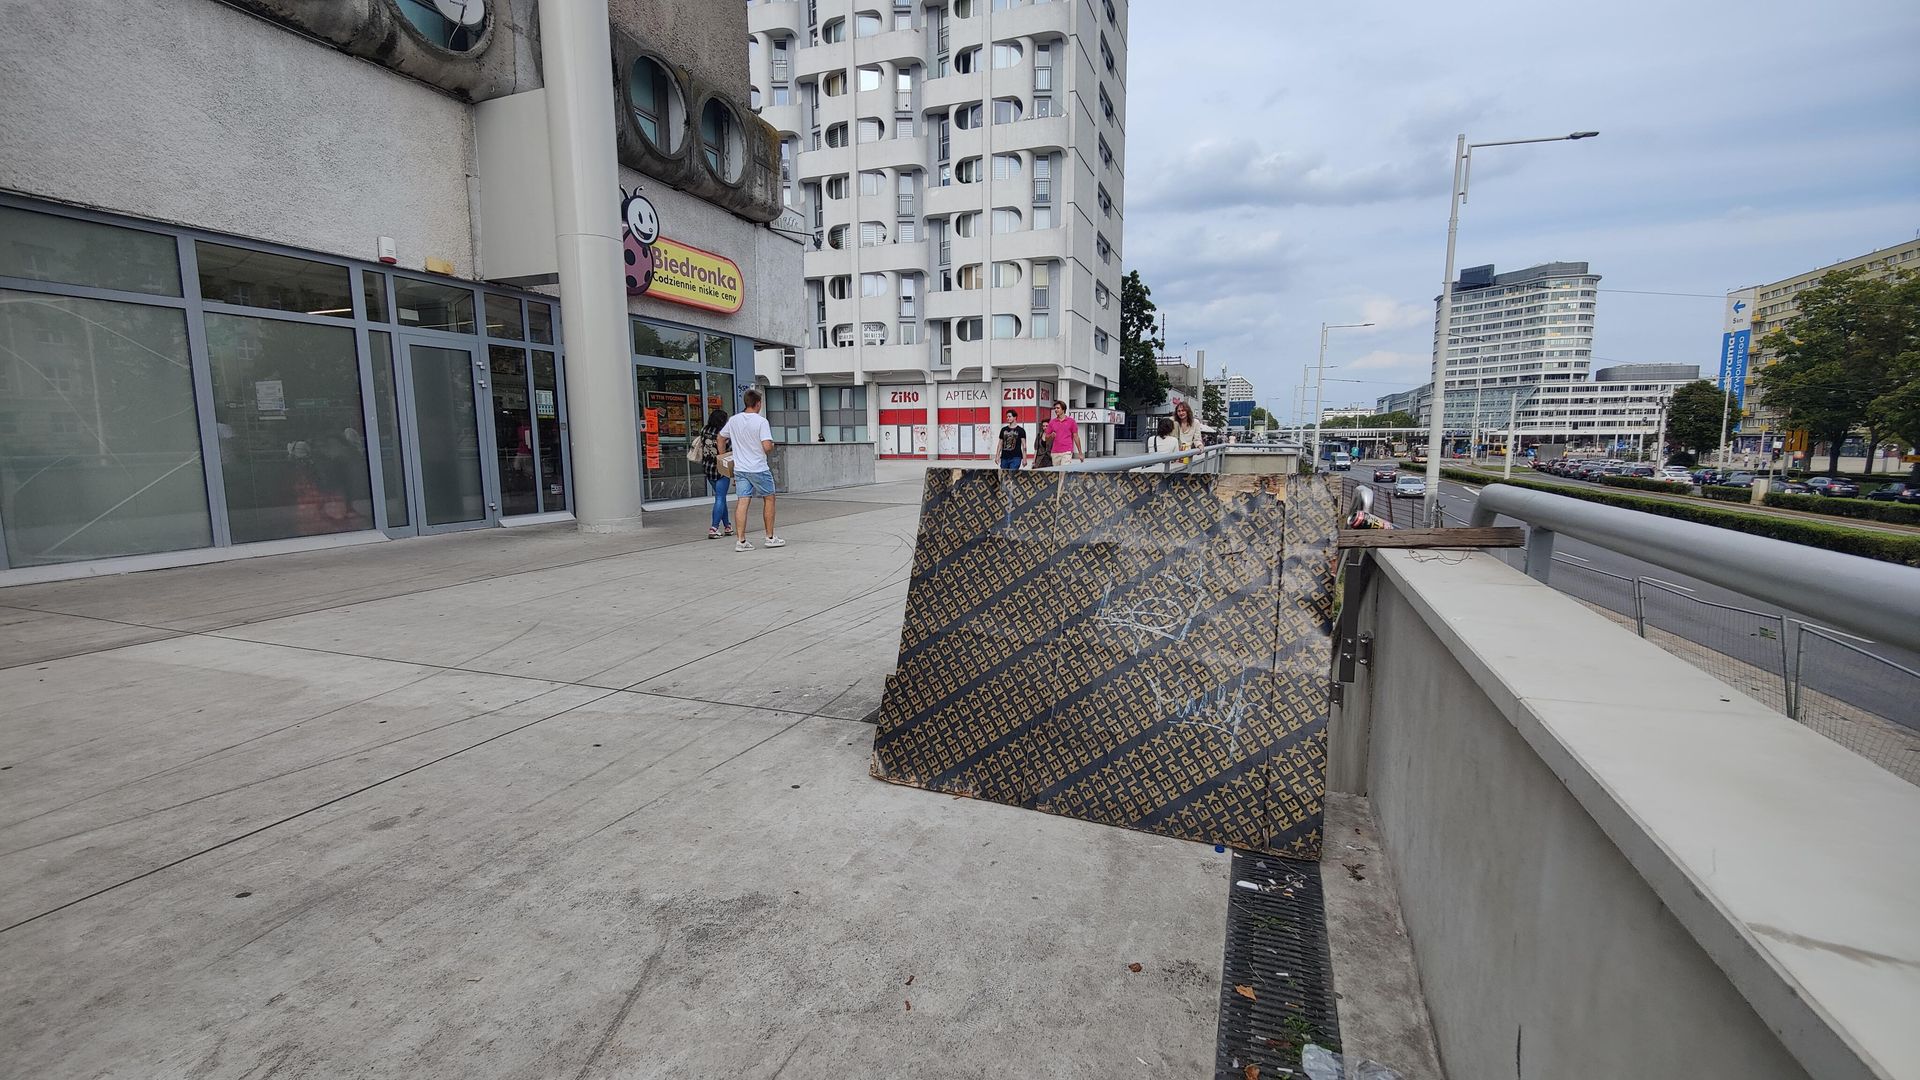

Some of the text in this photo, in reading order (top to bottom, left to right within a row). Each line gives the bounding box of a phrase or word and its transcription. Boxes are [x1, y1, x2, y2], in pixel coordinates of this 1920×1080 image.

[652, 246, 737, 291] Biedronka
[652, 271, 737, 304] Codziennie niskie ceny
[945, 390, 988, 401] APTEKA
[1034, 501, 1069, 548] REPLEX
[1067, 478, 1103, 525] REPLEX
[1147, 497, 1187, 546] REPLEX
[1158, 489, 1199, 538] REPLEX
[1170, 481, 1212, 530] REPLEX
[991, 530, 1025, 577] REPLEX
[1002, 523, 1036, 570] REPLEX
[1013, 516, 1047, 563] REPLEX
[1023, 508, 1058, 555] REPLEX
[1135, 505, 1175, 554] REPLEX
[950, 558, 982, 606] REPLEX
[960, 551, 992, 599] REPLEX
[970, 544, 1003, 592] REPLEX
[981, 537, 1014, 585] REPLEX
[1055, 558, 1092, 608] REPLEX
[1066, 550, 1104, 600] REPLEX
[1184, 549, 1227, 601] REPLEX
[1196, 541, 1240, 593] REPLEX
[909, 586, 939, 634] REPLEX
[919, 579, 950, 627] REPLEX
[929, 572, 960, 620] REPLEX
[939, 565, 971, 613] REPLEX
[1011, 587, 1046, 637] REPLEX
[1022, 580, 1058, 630] REPLEX
[1033, 572, 1069, 622] REPLEX
[1044, 565, 1080, 615] REPLEX
[1148, 572, 1189, 625] REPLEX
[1160, 564, 1202, 617] REPLEX
[968, 615, 1002, 665] REPLEX
[979, 608, 1013, 658] REPLEX
[989, 601, 1024, 651] REPLEX
[1000, 594, 1035, 644] REPLEX
[1077, 617, 1116, 671] REPLEX
[1088, 610, 1128, 663] REPLEX
[1211, 612, 1257, 668] REPLEX
[1224, 604, 1270, 660] REPLEX
[1237, 596, 1283, 652] REPLEX
[926, 643, 958, 693] REPLEX
[936, 636, 968, 686] REPLEX
[947, 629, 979, 679] REPLEX
[957, 622, 990, 672] REPLEX
[1031, 646, 1068, 700] REPLEX
[1043, 639, 1080, 693] REPLEX
[1054, 632, 1092, 685] REPLEX
[1065, 625, 1104, 678] REPLEX
[1161, 643, 1204, 699] REPLEX
[1173, 635, 1217, 692] REPLEX
[1186, 628, 1230, 684] REPLEX
[1198, 620, 1243, 676] REPLEX
[894, 663, 925, 714] REPLEX
[905, 656, 936, 707] REPLEX
[915, 649, 947, 700] REPLEX
[998, 668, 1034, 721] REPLEX
[1009, 661, 1045, 714] REPLEX
[1020, 654, 1057, 707] REPLEX
[1124, 666, 1166, 722] REPLEX
[1136, 658, 1179, 715] REPLEX
[1148, 651, 1191, 707] REPLEX
[1253, 671, 1302, 731] REPLEX
[1267, 663, 1316, 723] REPLEX
[1280, 655, 1330, 715] REPLEX
[954, 696, 988, 749] REPLEX
[965, 689, 999, 742] REPLEX
[976, 682, 1011, 735] REPLEX
[987, 675, 1022, 728] REPLEX
[1076, 695, 1116, 752] REPLEX
[1088, 688, 1128, 744] REPLEX
[1100, 680, 1141, 737] REPLEX
[1112, 673, 1153, 730] REPLEX
[1213, 694, 1260, 755] REPLEX
[1226, 687, 1274, 747] REPLEX
[1240, 679, 1288, 739] REPLEX
[911, 723, 943, 777] REPLEX
[921, 716, 954, 770] REPLEX
[932, 709, 965, 763] REPLEX
[943, 702, 977, 756] REPLEX
[1030, 724, 1067, 781] REPLEX
[1041, 717, 1079, 773] REPLEX
[1053, 709, 1092, 766] REPLEX
[1064, 702, 1104, 759] REPLEX
[1162, 725, 1207, 785] REPLEX
[1175, 717, 1220, 778] REPLEX
[1187, 710, 1233, 770] REPLEX
[1200, 702, 1247, 762] REPLEX
[1007, 738, 1043, 795] REPLEX
[1018, 731, 1055, 788] REPLEX
[1112, 755, 1154, 815] REPLEX
[1124, 747, 1167, 808] REPLEX
[1137, 740, 1180, 800] REPLEX
[1149, 732, 1193, 793] REPLEX
[1271, 750, 1322, 815] REPLEX
[1100, 762, 1142, 823] REPLEX
[1216, 782, 1265, 846] REPLEX
[1243, 766, 1293, 831] REPLEX
[1257, 758, 1307, 823] REPLEX
